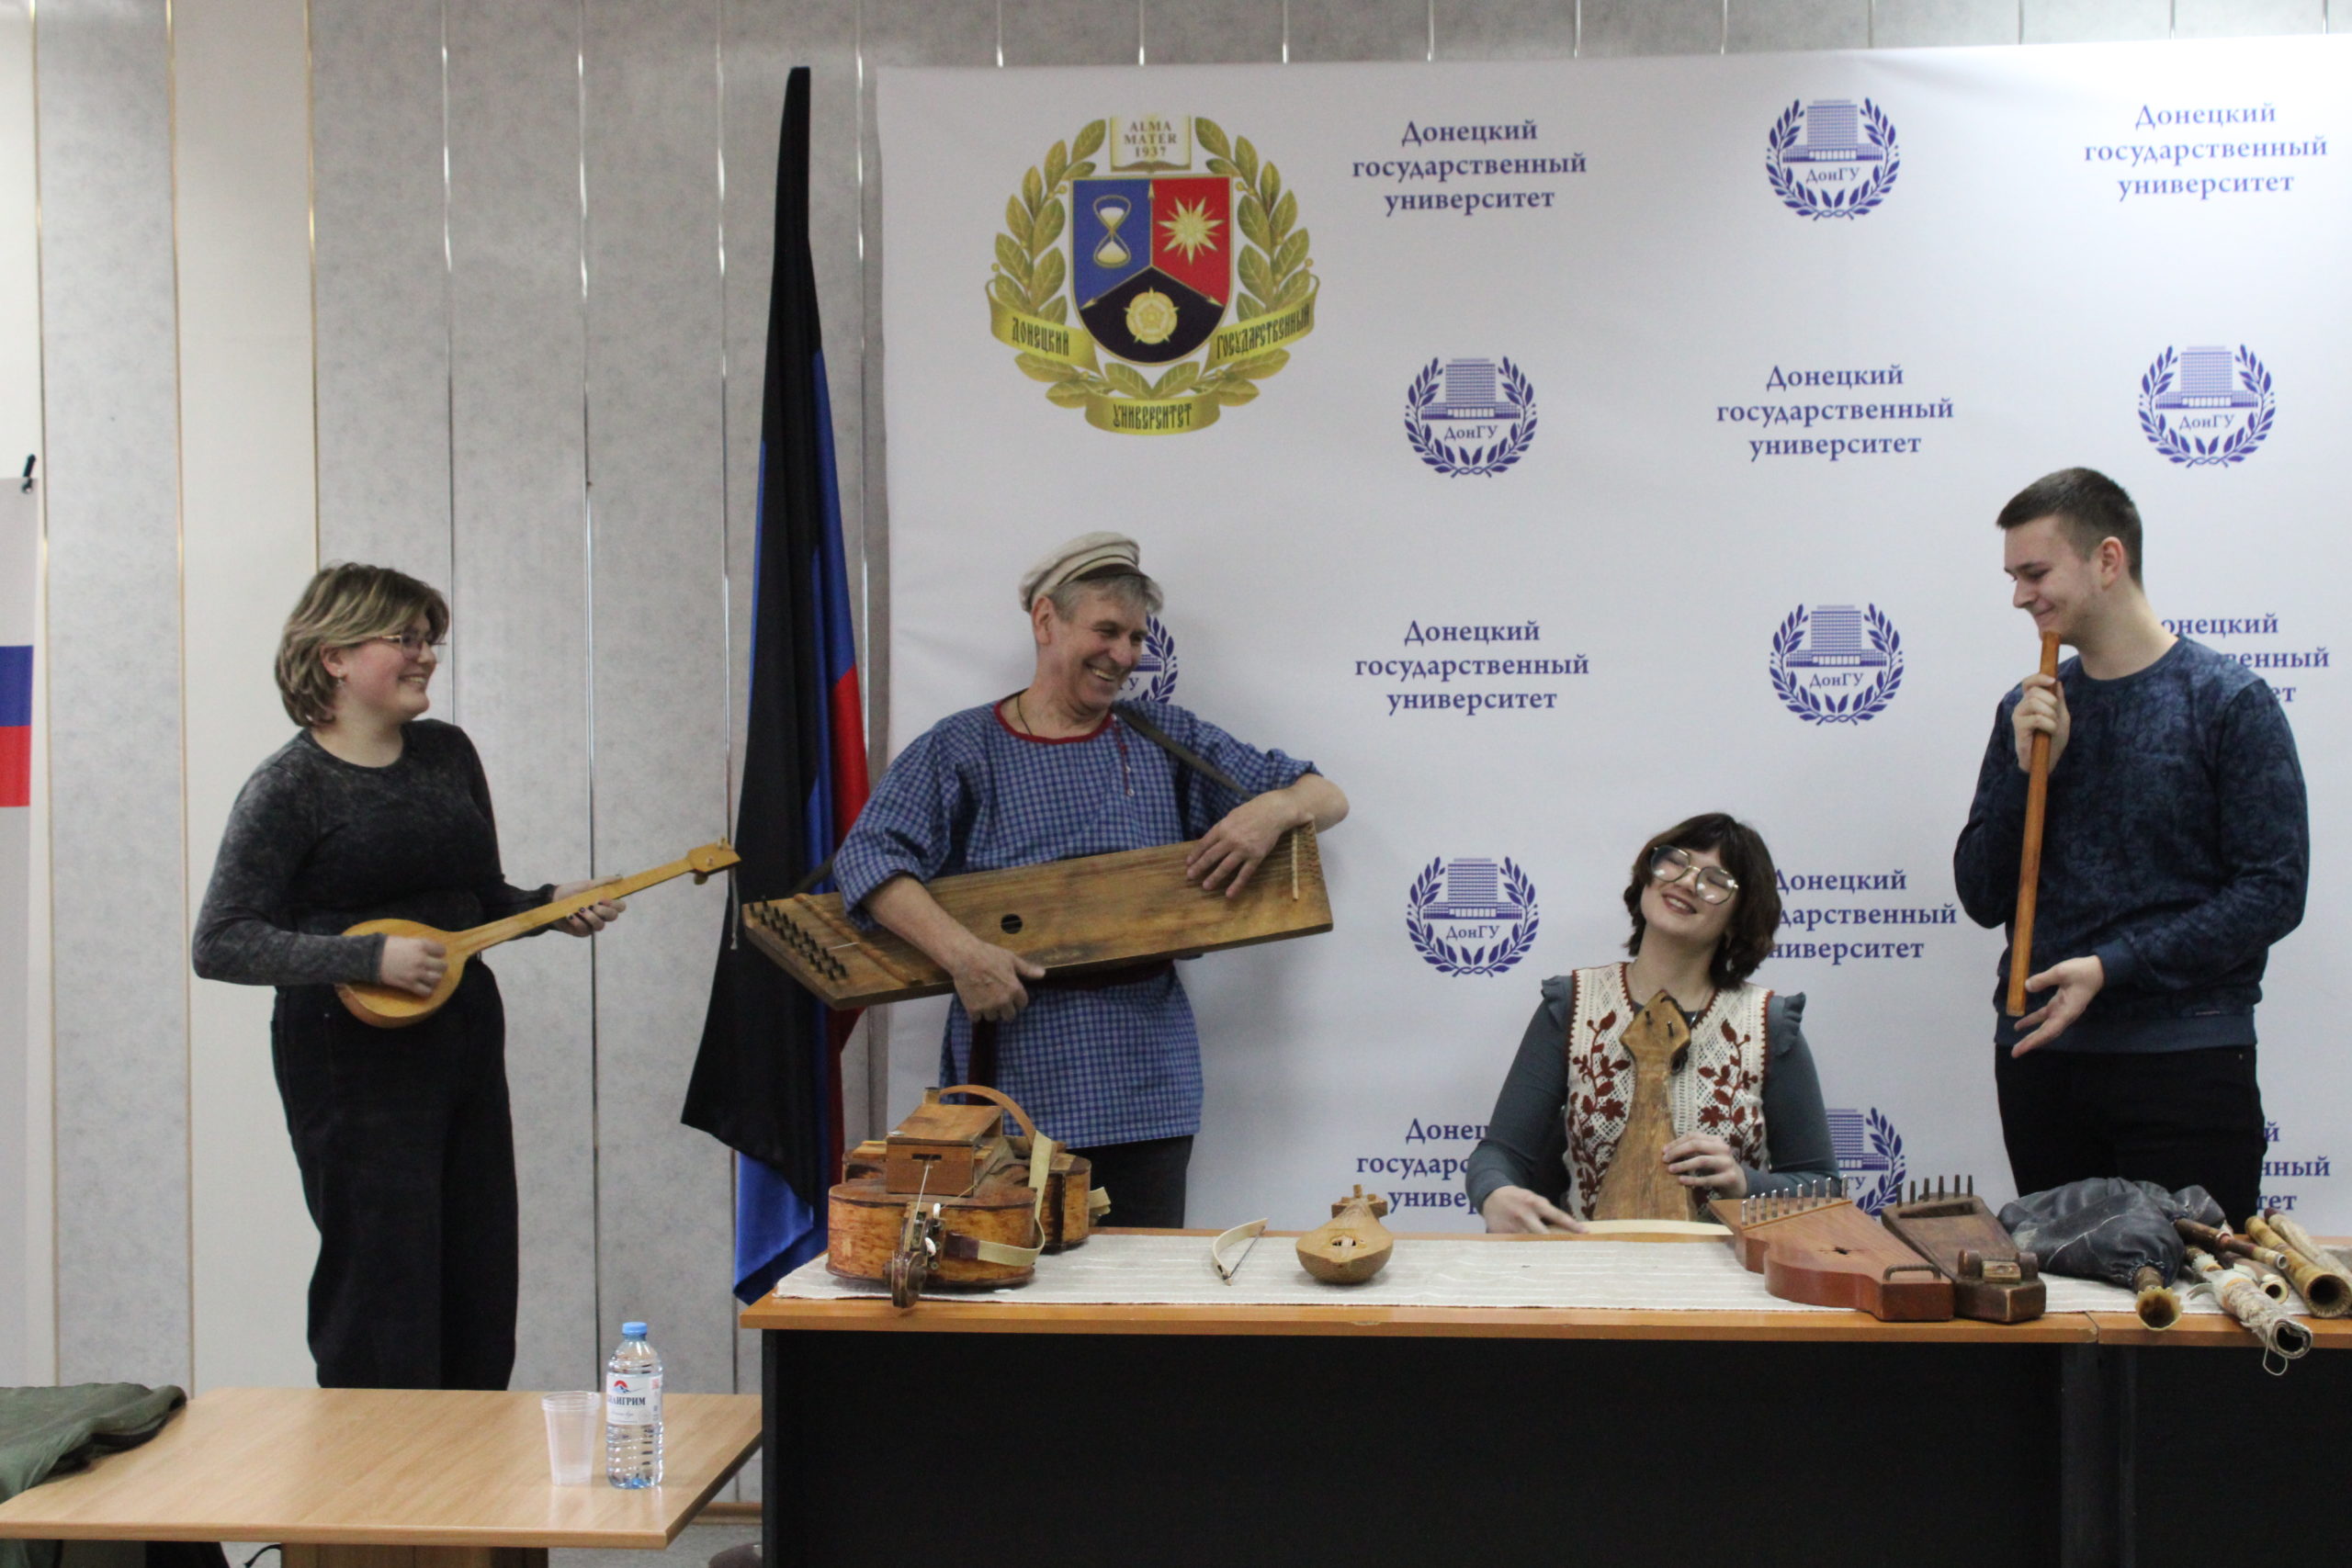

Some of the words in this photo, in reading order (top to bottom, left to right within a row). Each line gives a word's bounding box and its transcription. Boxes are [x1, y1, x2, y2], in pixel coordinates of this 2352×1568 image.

[1130, 120, 1171, 132] ALMA
[2134, 103, 2277, 129] Донецкий
[1124, 133, 1177, 144] MATER
[1401, 119, 1538, 146] Донецкий
[1136, 146, 1166, 157] 1937
[2085, 136, 2327, 164] государственный
[1352, 152, 1587, 182] государственный
[1805, 166, 1860, 184] ДонГУ
[2117, 175, 2295, 202] университет
[1384, 189, 1555, 217] университет
[1766, 364, 1905, 391] Донецкий
[1716, 398, 1954, 427] государственный
[2178, 413, 2235, 432] ДонГУ
[1443, 424, 1498, 442] ДонГУ
[1748, 434, 1922, 462] университет
[1404, 620, 1541, 647] Донецкий
[2161, 613, 2278, 637] онецкий
[1355, 653, 1589, 682] государственный
[1809, 672, 1865, 689] ДонГУ
[1386, 690, 1558, 716] университет
[1781, 903, 1957, 931] дарственный
[1445, 924, 1500, 941] ДонГУ
[1769, 942, 1924, 965] ниверситет
[1405, 1118, 1488, 1145] Донец
